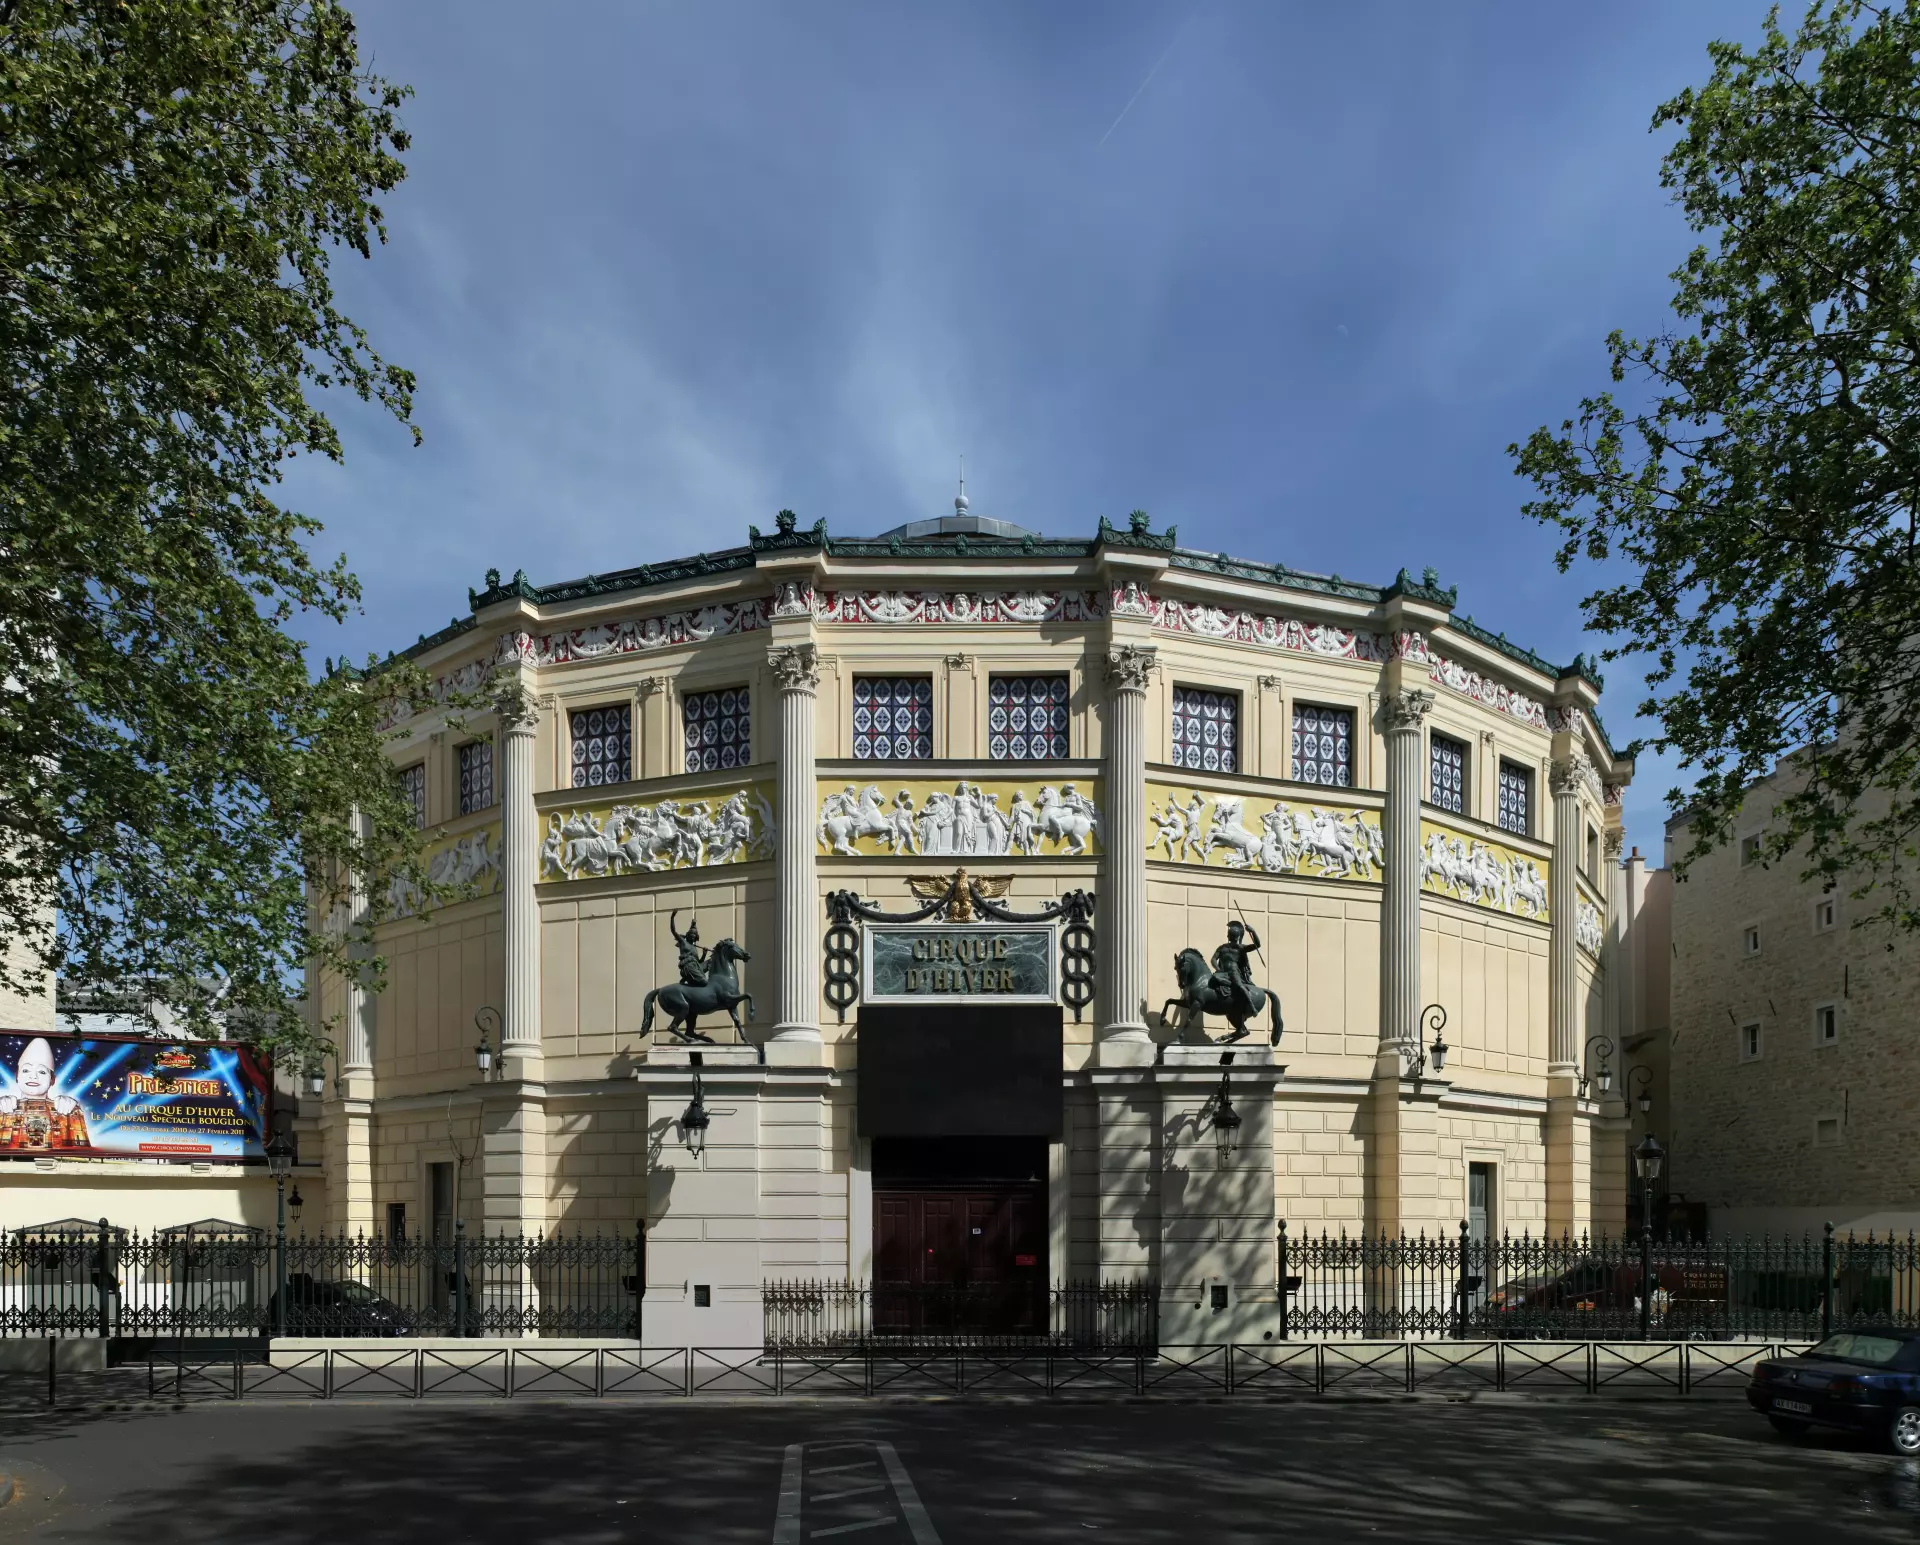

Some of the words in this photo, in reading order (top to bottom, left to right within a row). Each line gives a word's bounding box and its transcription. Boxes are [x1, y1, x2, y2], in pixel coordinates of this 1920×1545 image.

[912, 939, 1008, 965] CIRQUE
[905, 968, 1014, 991] D'HIVER
[115, 1104, 131, 1113] AU
[134, 1104, 182, 1115] CIRQUE
[186, 1106, 235, 1117] D'HIVER
